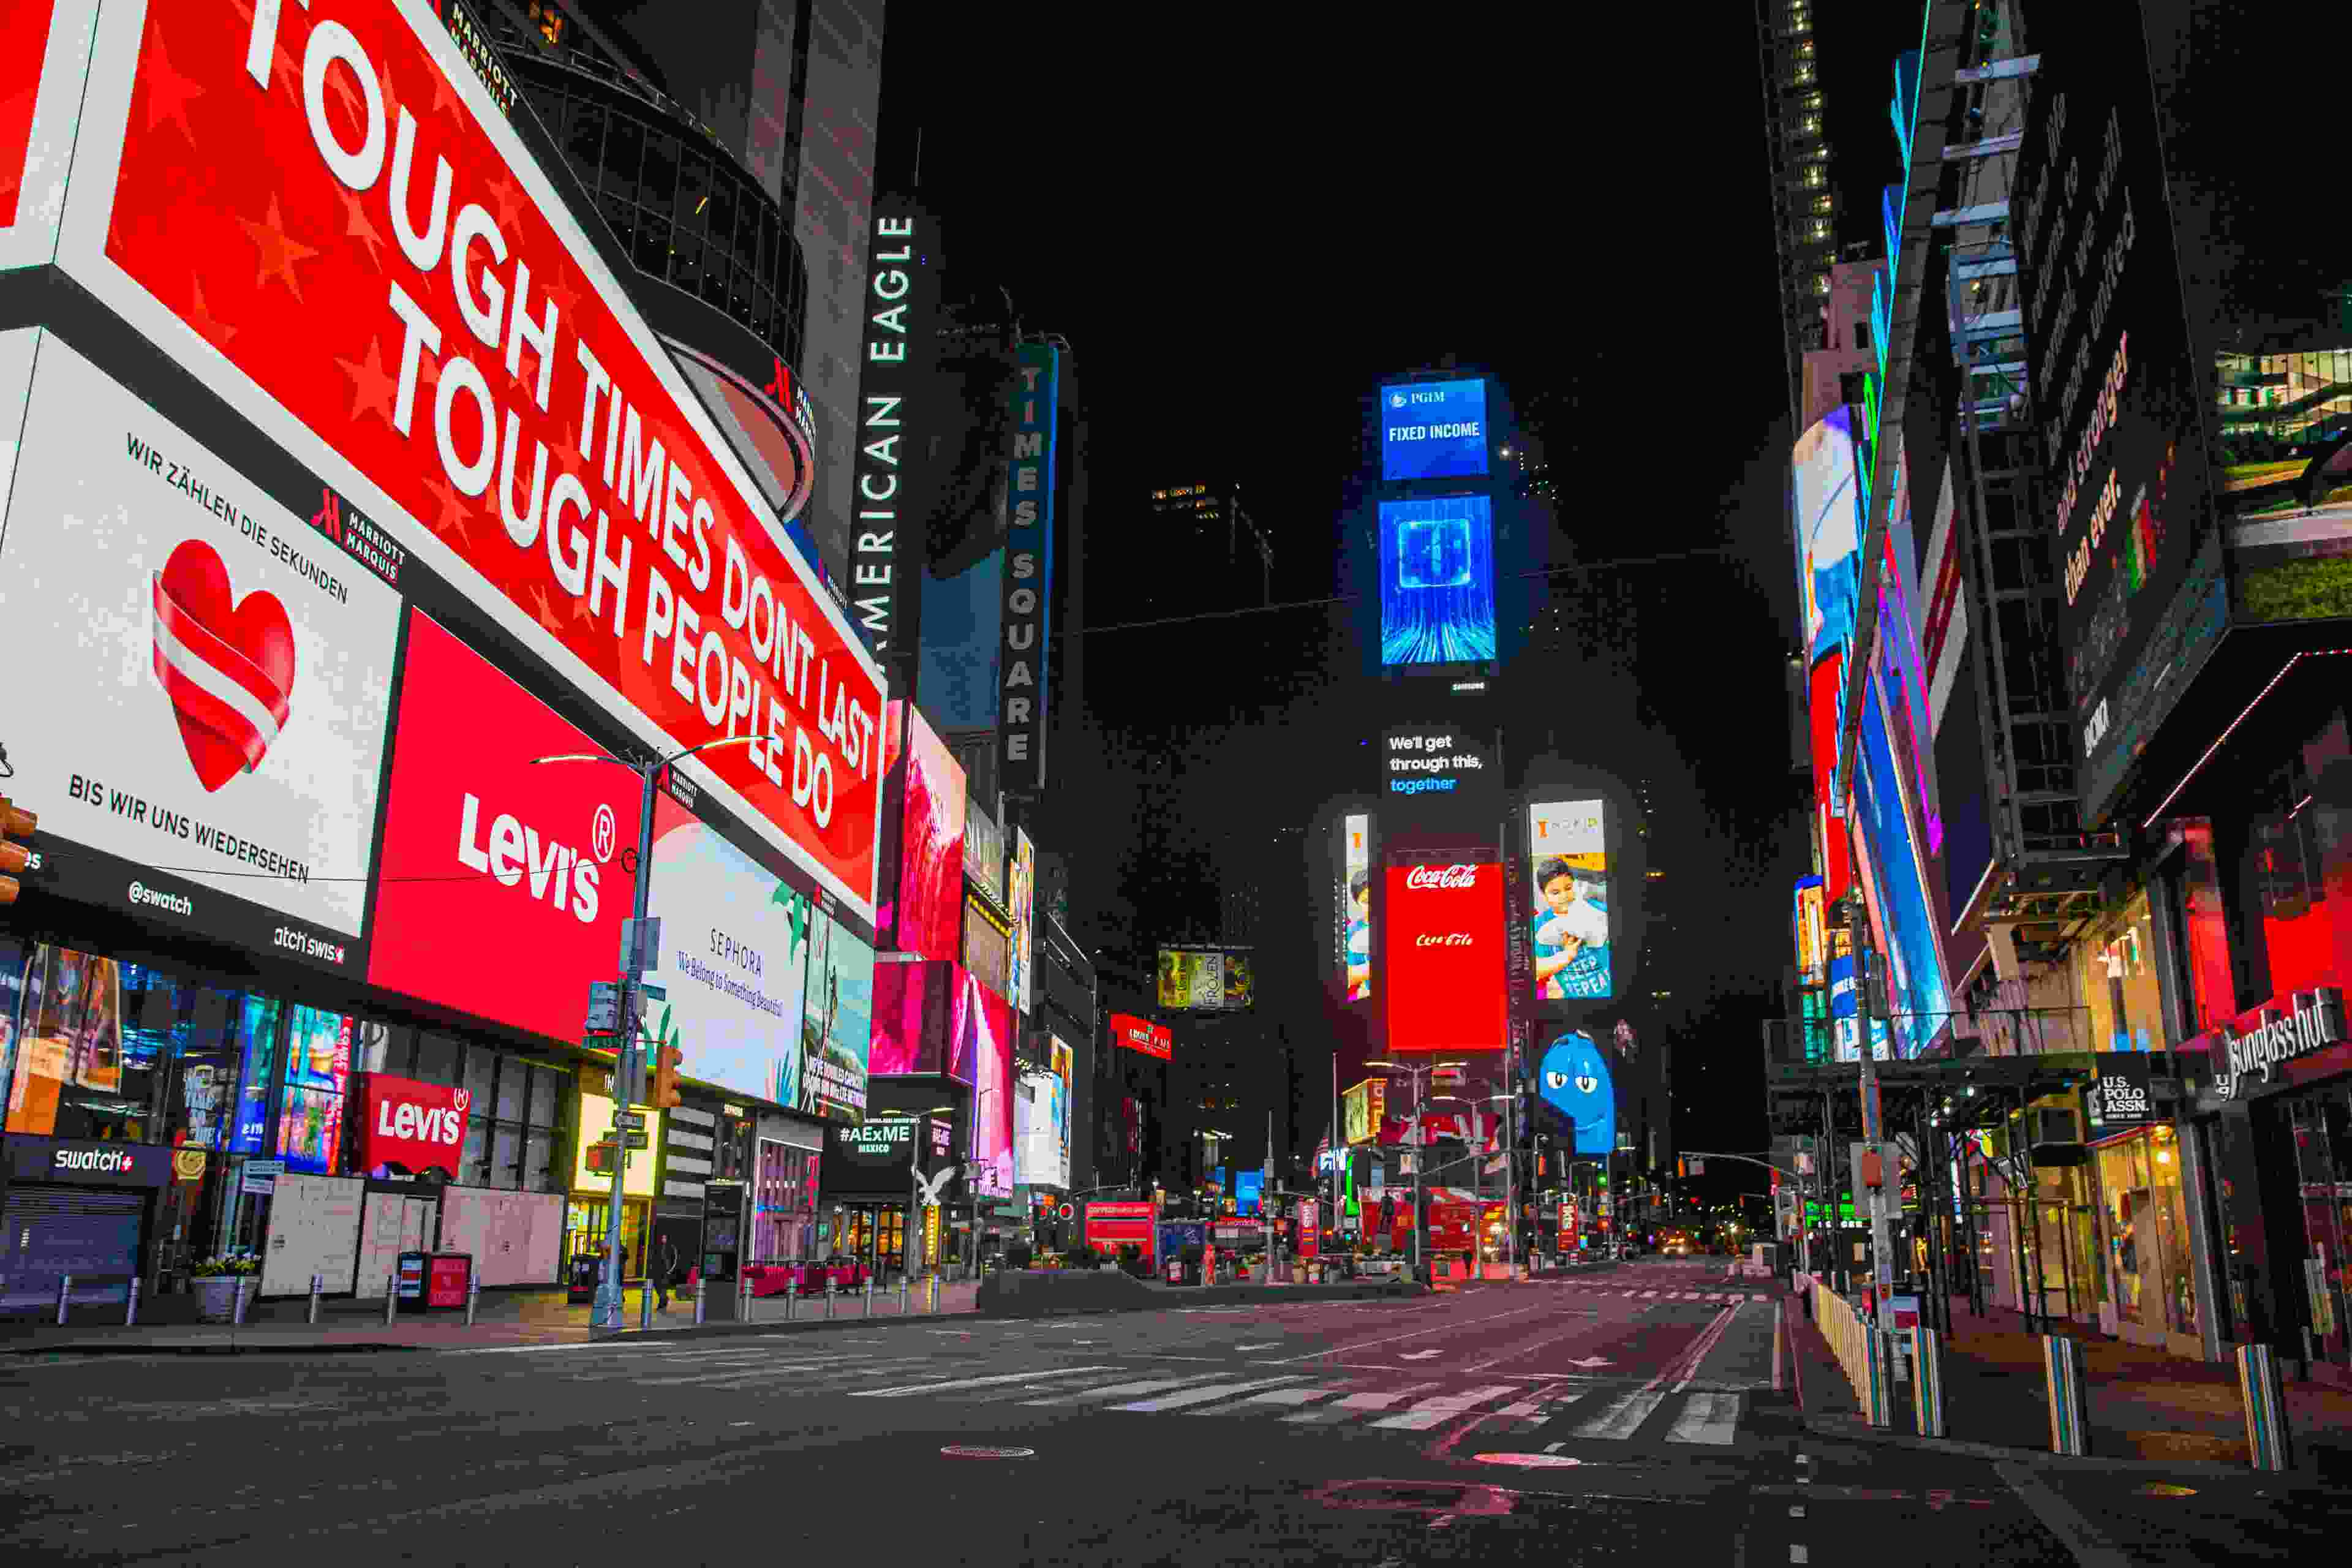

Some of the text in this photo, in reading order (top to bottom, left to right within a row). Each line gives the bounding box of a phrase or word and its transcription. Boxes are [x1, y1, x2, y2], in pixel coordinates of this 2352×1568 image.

[451, 2, 518, 107] MARRIOTT
[2089, 186, 2136, 341] united
[870, 217, 913, 363] EAGLE
[1411, 391, 1445, 403] PGIM
[1389, 422, 1480, 441] FIXED INCOME
[2058, 331, 2128, 537] and stronger
[127, 432, 348, 605] WIR ZÄHLEN DIE SEKUNDEN
[349, 511, 405, 565] MARRIOTT
[2065, 537, 2091, 606] than
[2090, 467, 2122, 549] ever.
[346, 533, 398, 582] MARQUIS
[390, 281, 833, 829] TOUGH PEOPLE DO
[578, 339, 714, 592] TIMES
[722, 534, 814, 709] DONT
[818, 657, 873, 780] LAST
[1006, 366, 1042, 761] TIMES SQUARE
[1390, 735, 1452, 752] We'll get
[1390, 754, 1482, 773] through this,
[1391, 777, 1456, 794] together
[69, 774, 309, 884] BIS WIR UNS WIEDERSEHEN
[1407, 864, 1479, 889] Coca-Cola
[128, 881, 192, 915] @swatch
[710, 927, 762, 978] SEPHORA
[715, 973, 725, 990] to
[2102, 1076, 2131, 1088] U.S.
[2103, 1088, 2145, 1100] POLO
[2105, 1099, 2150, 1112] ASSN.
[840, 1126, 912, 1142] #AExME
[858, 1144, 891, 1154] MEXICO
[55, 1149, 124, 1170] swatch
